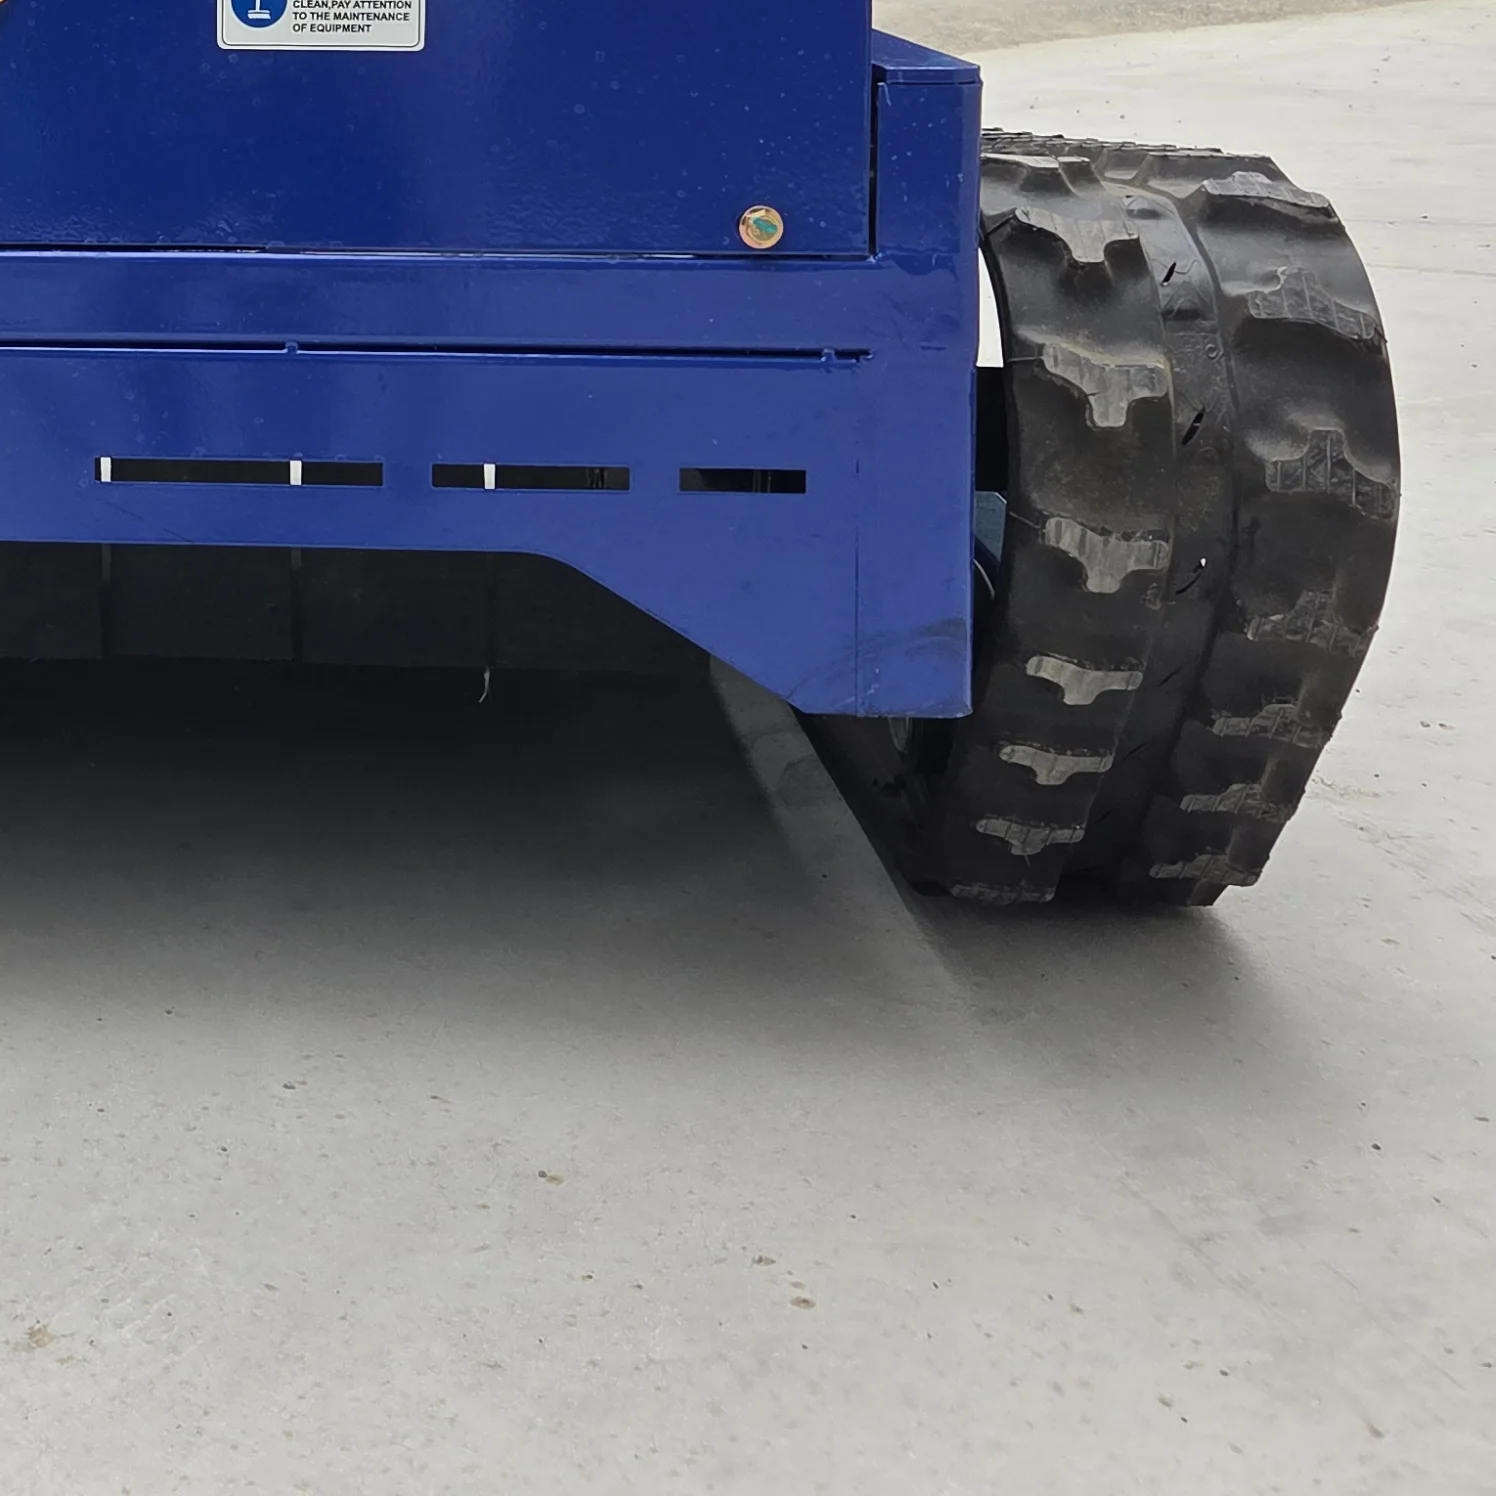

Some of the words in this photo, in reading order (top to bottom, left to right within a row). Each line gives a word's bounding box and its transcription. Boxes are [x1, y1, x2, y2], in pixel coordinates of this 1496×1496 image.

[354, 0, 412, 9] ATTENTION
[293, 12, 307, 21] TO
[310, 12, 330, 21] THE
[333, 12, 410, 21] MAINTENANCE
[293, 24, 307, 33] OF
[310, 24, 371, 33] EQUIPMENT
